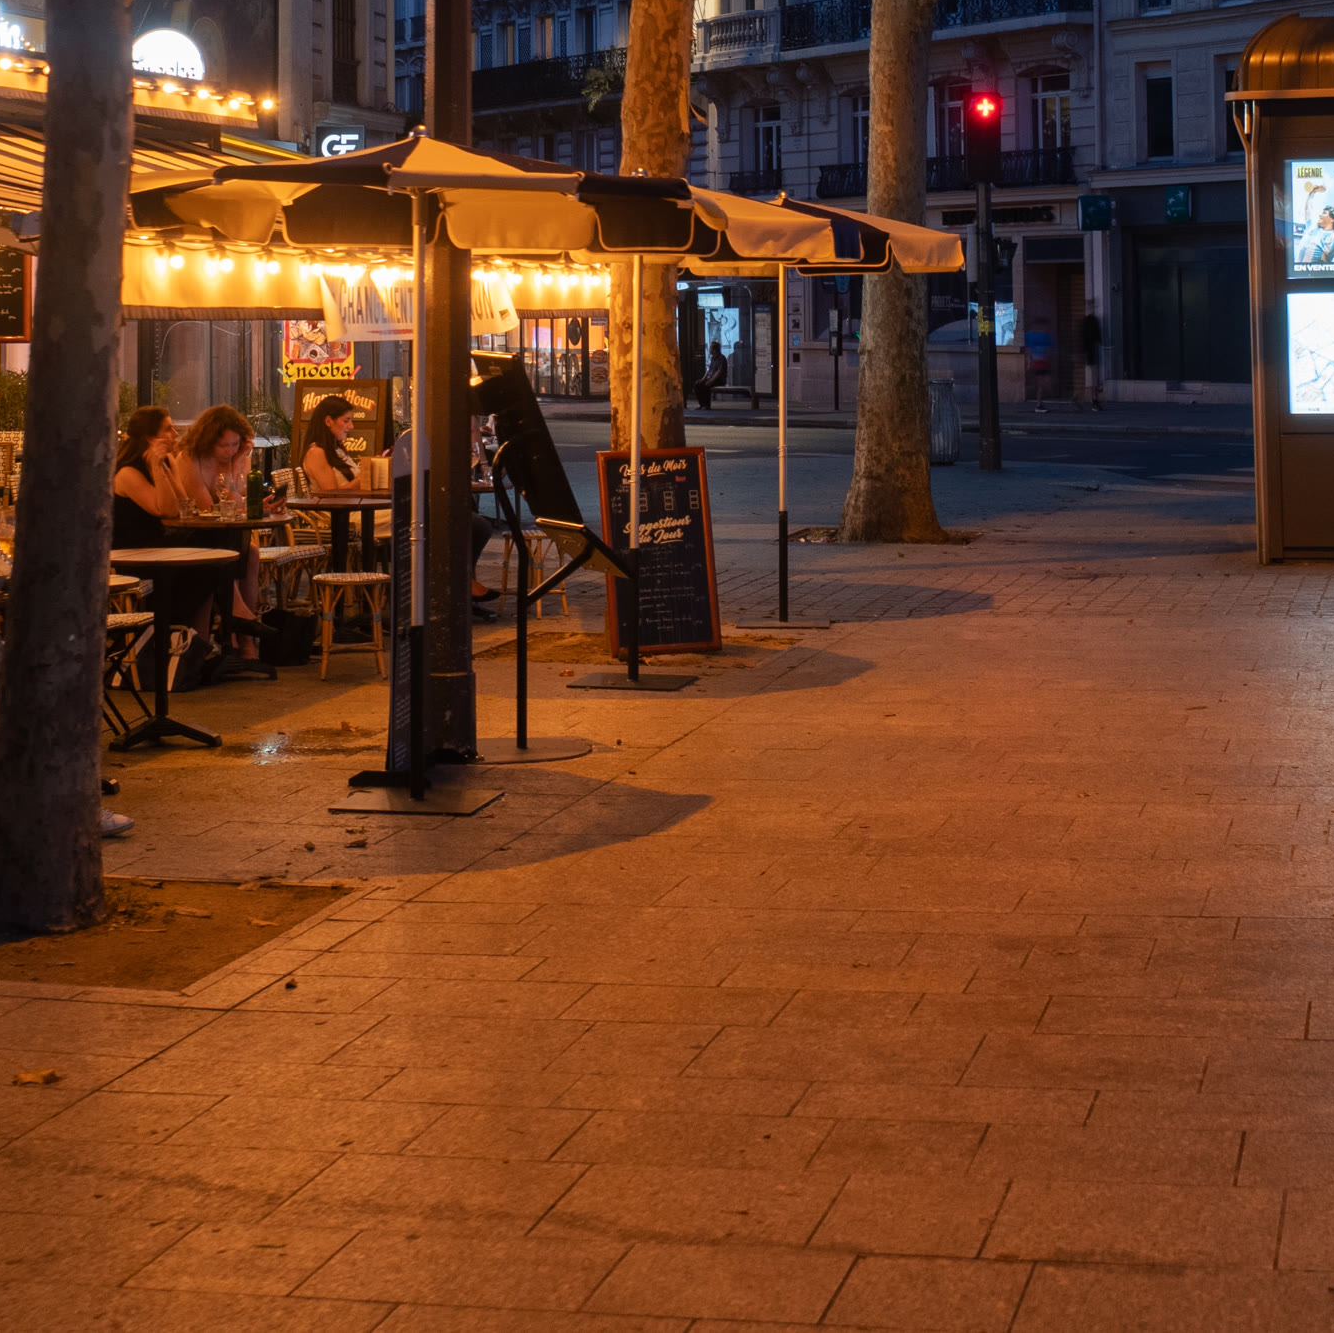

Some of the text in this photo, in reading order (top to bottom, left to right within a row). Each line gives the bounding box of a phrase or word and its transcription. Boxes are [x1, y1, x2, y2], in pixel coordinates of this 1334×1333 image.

[1297, 167, 1323, 178] LÉGENDE
[284, 361, 353, 379] Enooba
[344, 389, 377, 411] Hour
[663, 459, 687, 472] Mois
[622, 515, 691, 535] Sggestions
